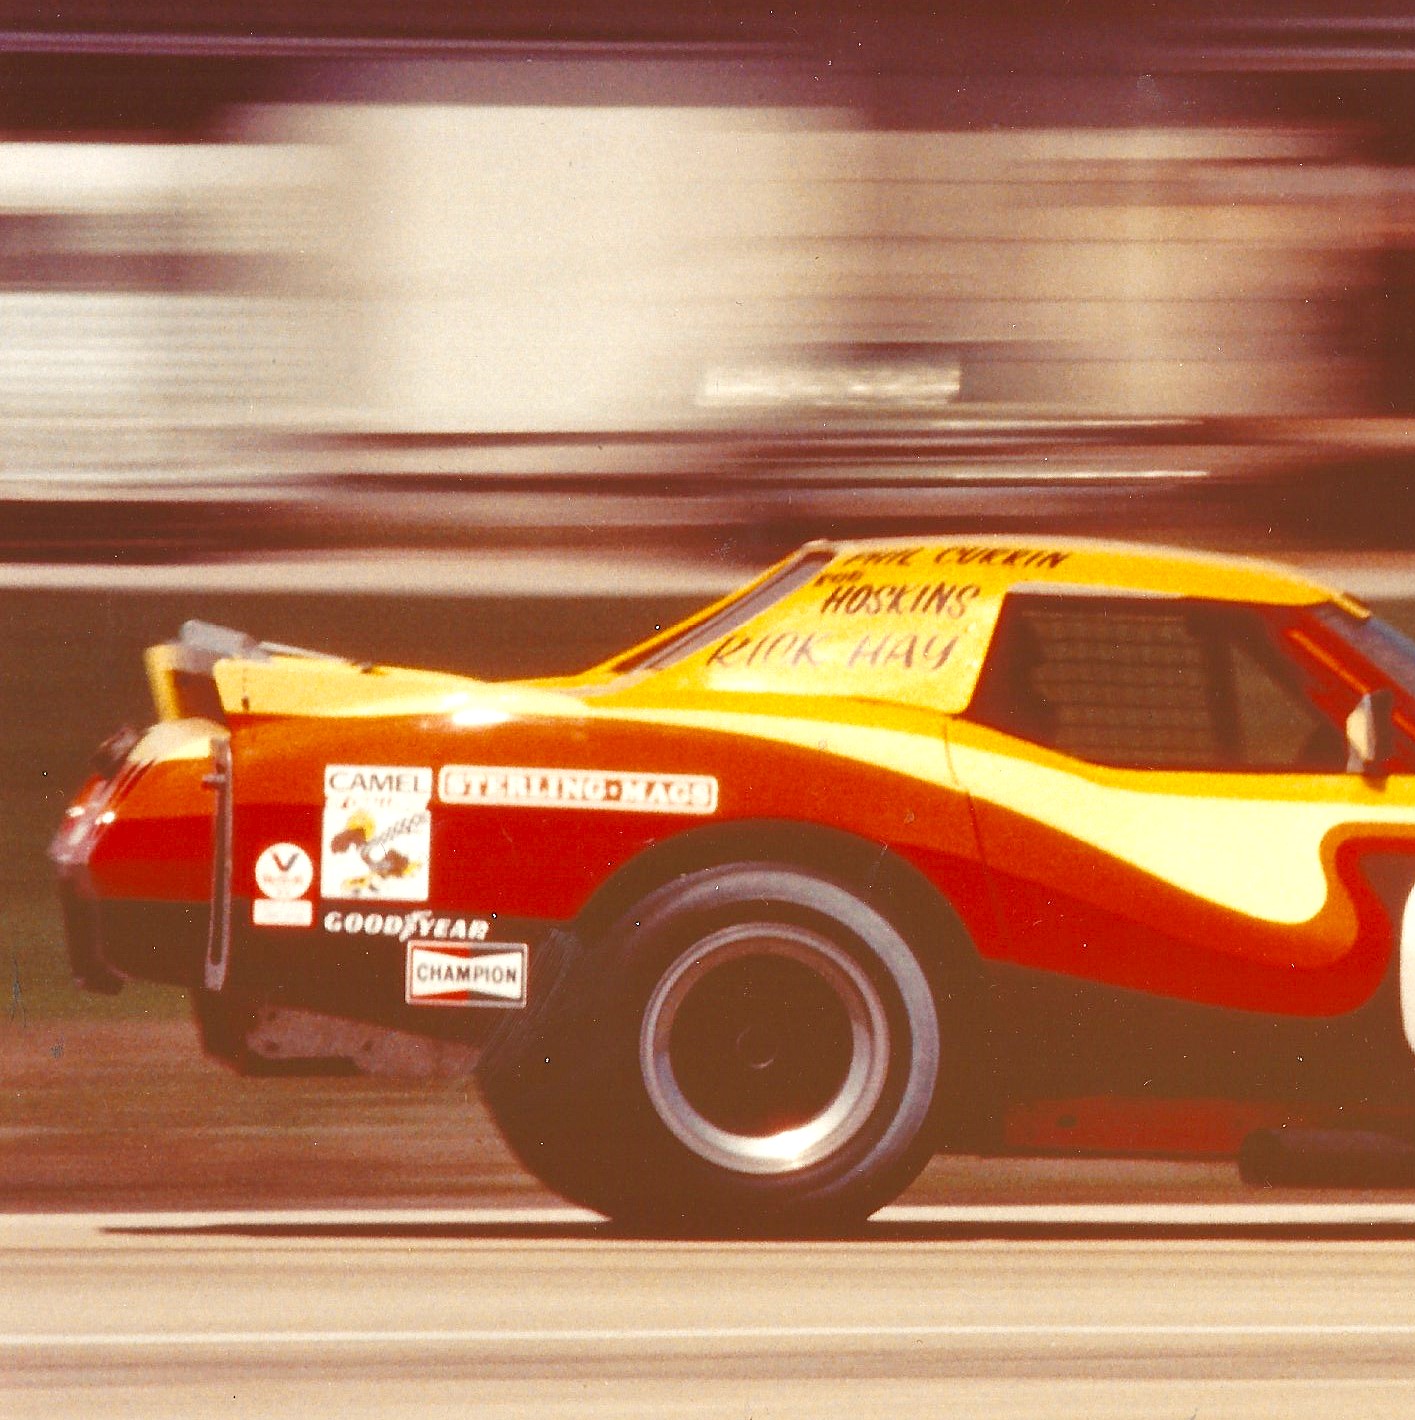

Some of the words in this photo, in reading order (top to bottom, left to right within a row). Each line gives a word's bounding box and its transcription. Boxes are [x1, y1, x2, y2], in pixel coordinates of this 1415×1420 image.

[820, 583, 981, 618] HOSKINS
[847, 634, 960, 671] HAY
[328, 771, 427, 793] CAMEL
[324, 910, 490, 943] GOODYEAR
[416, 963, 518, 984] CHAMPION
